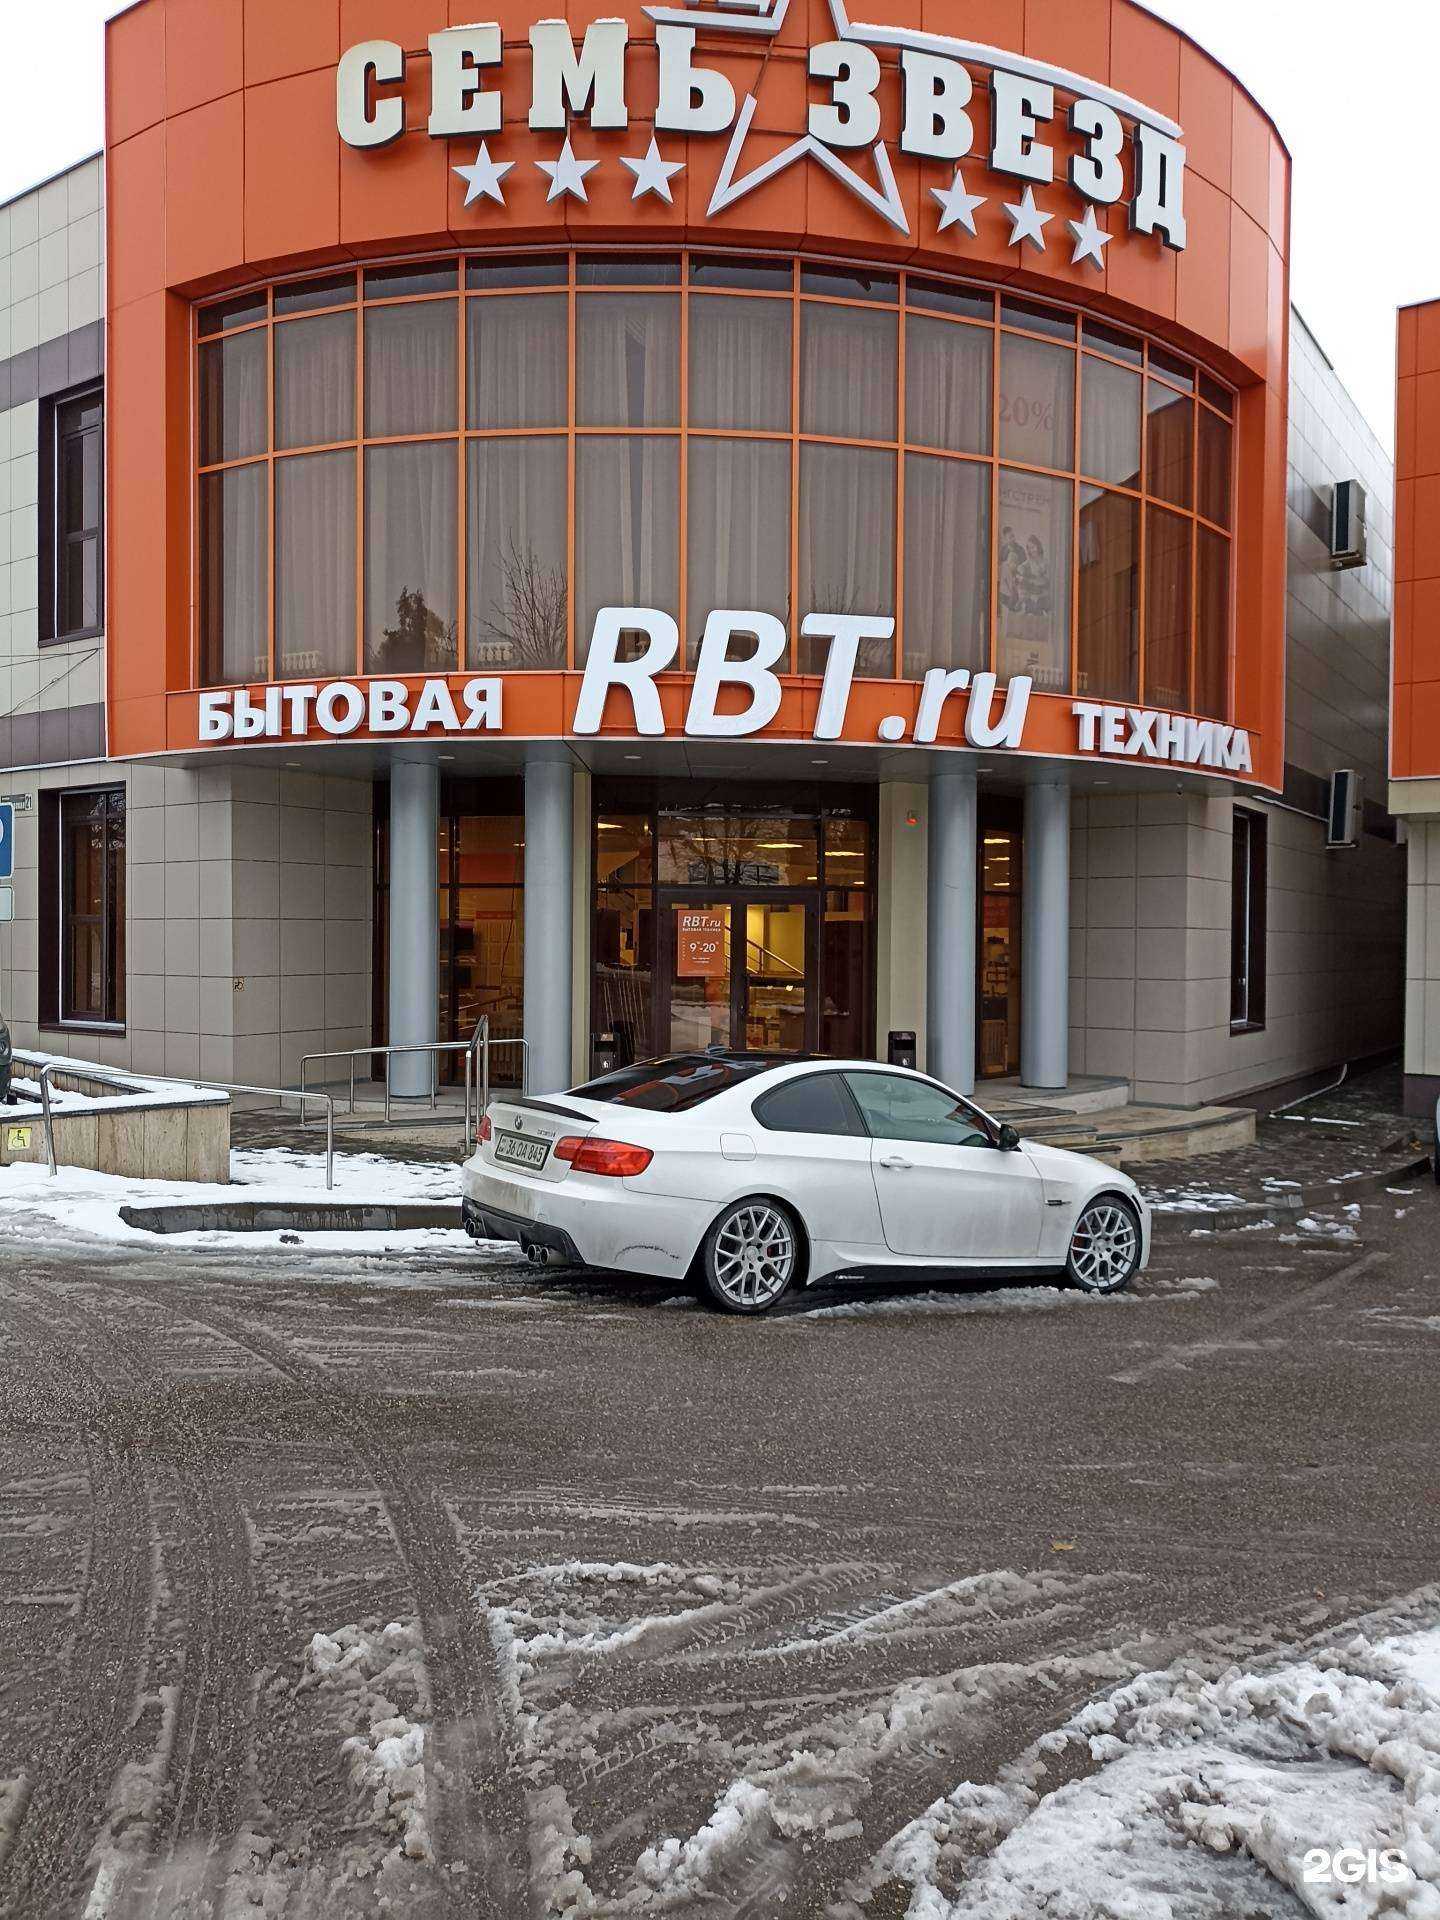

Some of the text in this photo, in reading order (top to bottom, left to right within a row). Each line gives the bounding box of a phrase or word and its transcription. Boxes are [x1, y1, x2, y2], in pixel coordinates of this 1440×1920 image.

[337, 21, 1187, 252] СЕМЬ ЗВЕЗД
[199, 677, 503, 741] БЫТОВАЯ
[572, 607, 1032, 748] RBT.ru
[1072, 702, 1253, 773] ТЕХНИКА
[682, 916, 721, 927] RBT.ru
